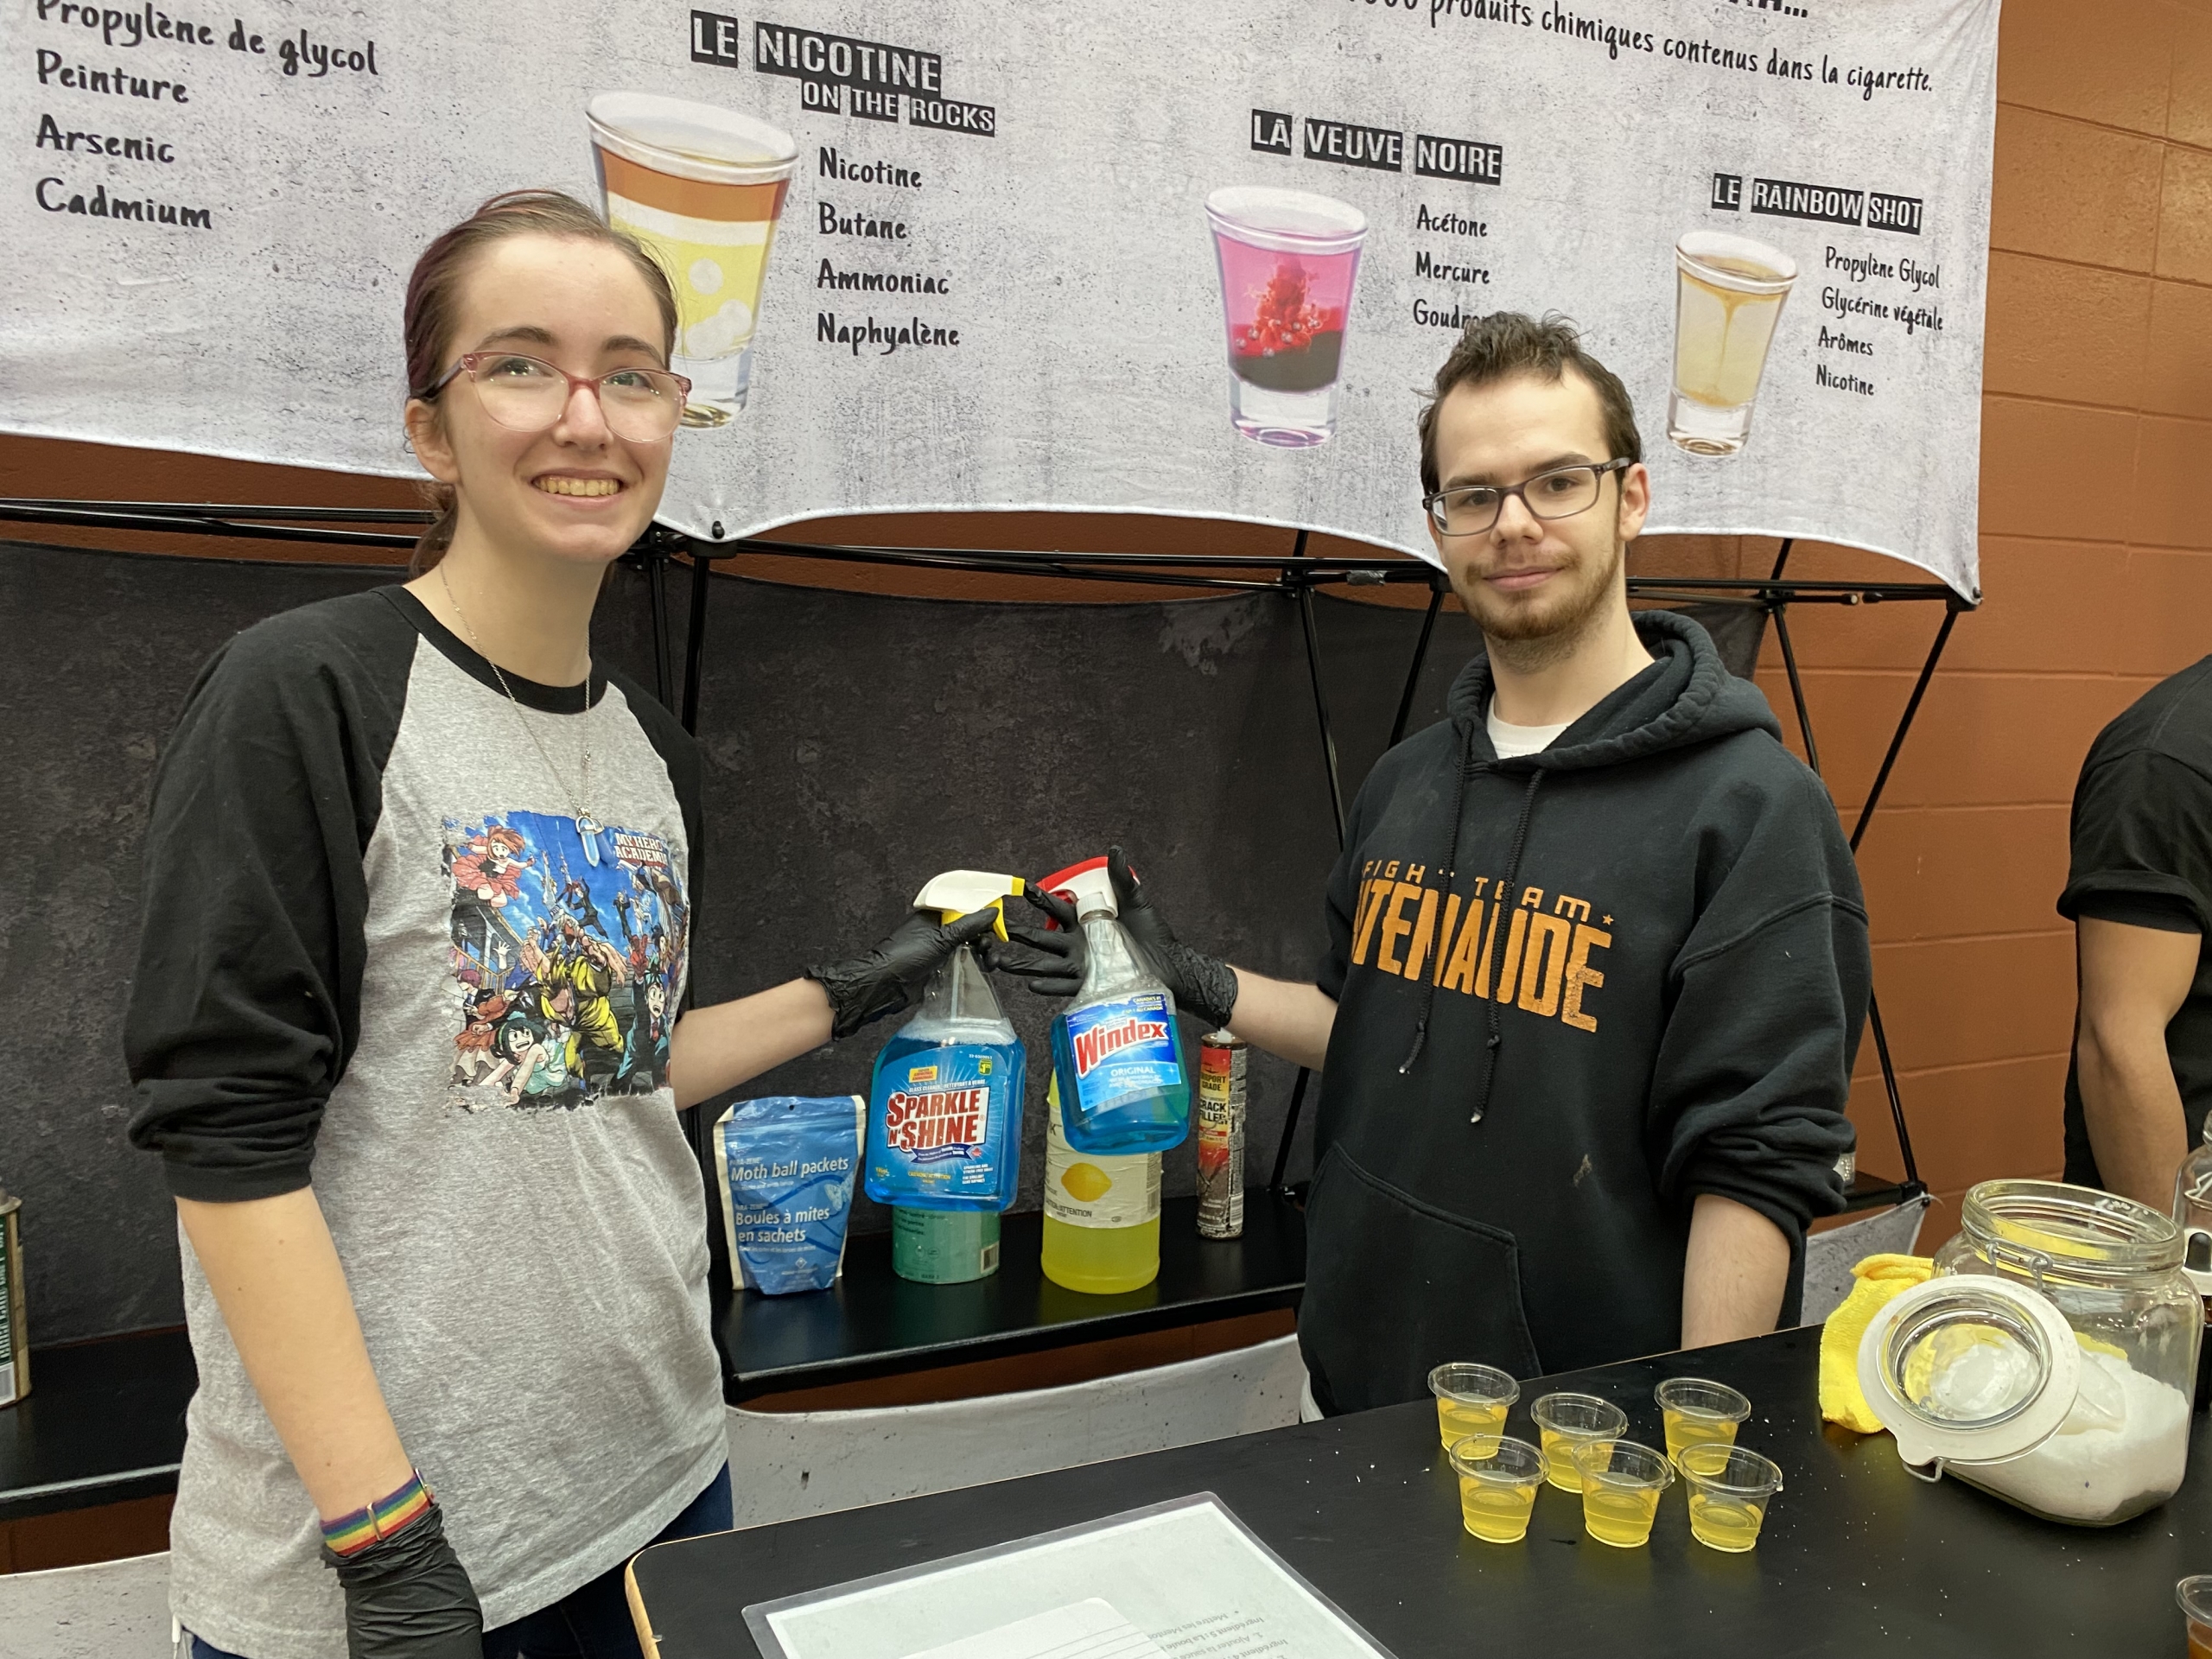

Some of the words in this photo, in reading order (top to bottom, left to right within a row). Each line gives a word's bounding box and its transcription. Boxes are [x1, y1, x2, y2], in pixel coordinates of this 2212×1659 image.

[36, 0, 214, 48] Propylène
[228, 18, 265, 54] de
[278, 29, 378, 78] glycol
[693, 18, 736, 59] LE
[759, 29, 939, 92] NICOTINE
[1431, 0, 1532, 29] produits
[1541, 0, 1654, 60] chimiques
[1663, 38, 1758, 72] contenus
[1766, 48, 1813, 80] dans
[1822, 54, 1838, 84] la
[1847, 67, 1933, 101] cigarette.
[36, 48, 189, 104] Peinture
[803, 82, 839, 109] ON
[852, 88, 898, 117] THE
[911, 98, 995, 132] ROCKS
[35, 113, 175, 163] Arsenic
[1254, 115, 1290, 149] LA
[1306, 123, 1401, 165] VEUVE
[1418, 139, 1500, 178] NOIRE
[819, 146, 922, 188] Nicotine
[35, 177, 212, 230] Cadmium
[818, 201, 907, 240] Butane
[1416, 203, 1487, 238] Acétone
[1713, 178, 1740, 205] LE
[1753, 182, 1863, 219] RAINBOW
[1869, 197, 1922, 228] SHOT
[817, 257, 950, 295] Ammoniac
[1415, 251, 1490, 284] Mercure
[1826, 245, 1894, 283] Propylène
[1899, 257, 1940, 289] Glycol
[1413, 298, 1481, 330] Goudr
[1821, 286, 1889, 320] Glycérine
[1893, 307, 1943, 335] végétale
[817, 312, 960, 355] Naphyalène
[1818, 325, 1873, 356] Arômes
[1816, 364, 1874, 396] Nicotine
[614, 833, 633, 847] MY
[1362, 860, 1455, 884] FIGH
[1075, 1019, 1166, 1075] Windex
[1110, 1066, 1156, 1077] ORIGINAL
[887, 1090, 981, 1127] SPARKLE
[731, 1164, 767, 1182] Moth
[772, 1160, 798, 1178] ball
[800, 1157, 849, 1179] packets
[735, 1210, 779, 1226] Boules
[783, 1209, 791, 1224] à
[795, 1206, 830, 1224] mites
[738, 1230, 754, 1243] en
[757, 1227, 806, 1243] sachets
